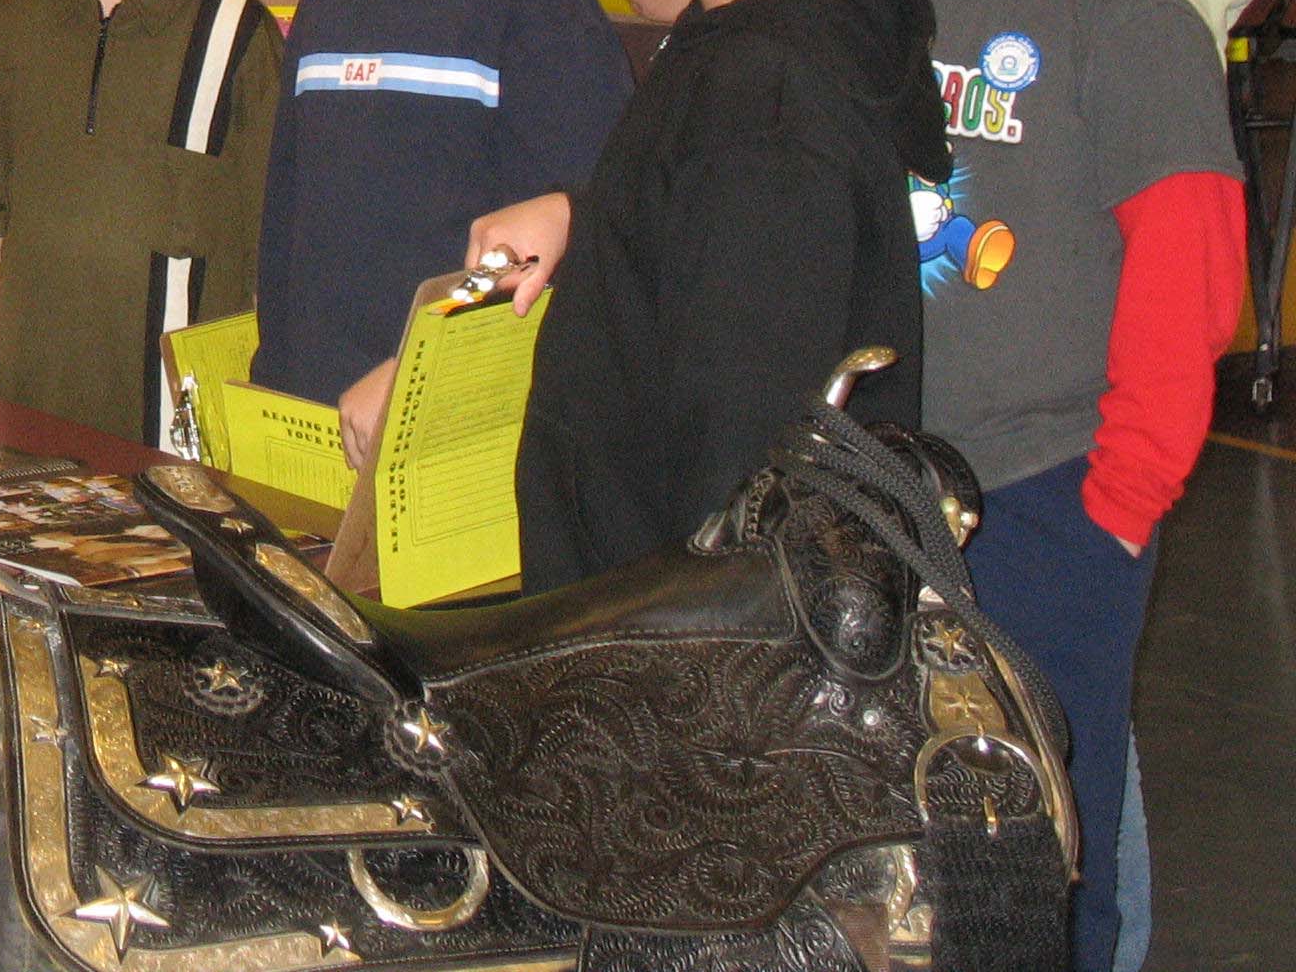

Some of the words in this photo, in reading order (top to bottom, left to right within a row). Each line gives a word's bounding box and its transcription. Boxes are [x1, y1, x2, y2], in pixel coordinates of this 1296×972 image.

[344, 62, 378, 82] GAP
[932, 68, 1019, 138] ROS.
[262, 409, 322, 432] READING
[287, 427, 322, 445] YOUR
[398, 459, 406, 514] YOUR
[388, 461, 398, 553] READING
